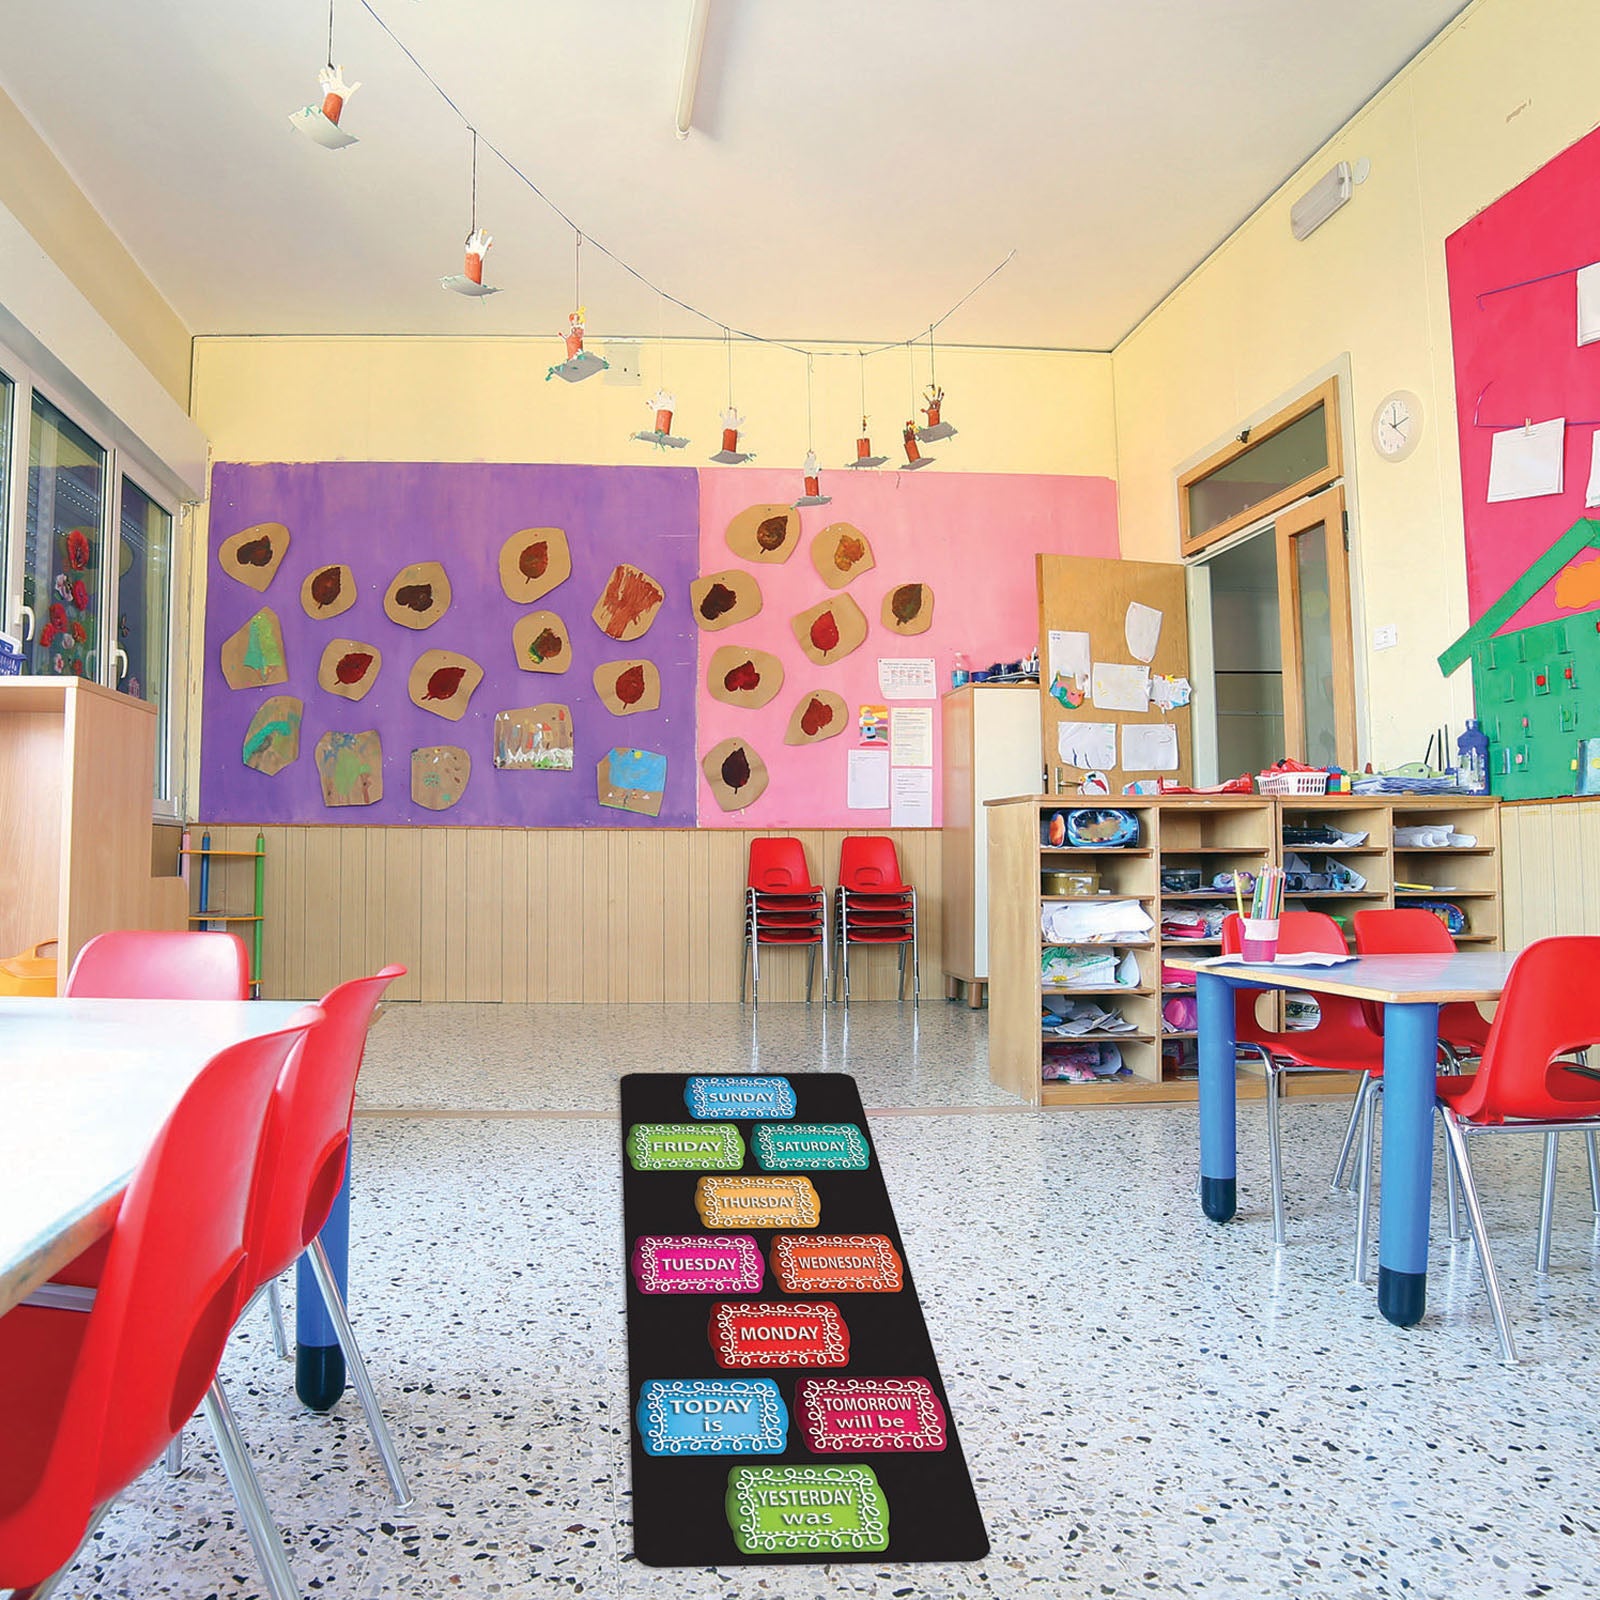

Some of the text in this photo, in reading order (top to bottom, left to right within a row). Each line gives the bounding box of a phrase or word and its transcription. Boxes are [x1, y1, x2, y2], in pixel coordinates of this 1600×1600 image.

[709, 1092, 774, 1104] SUNDAY
[652, 1141, 722, 1152] FRIDAY
[776, 1141, 846, 1152] SATURDAY
[720, 1196, 796, 1208] THURSDAY
[662, 1258, 737, 1271] TUESDAY
[797, 1256, 877, 1270] WEDNESDAY
[740, 1326, 819, 1341] MONDAY
[669, 1399, 753, 1414] TODAY
[823, 1398, 912, 1411] TOMORROW
[703, 1416, 723, 1432] is
[836, 1415, 905, 1429] will be
[756, 1489, 853, 1506] YESTERDAY
[782, 1511, 833, 1525] was
